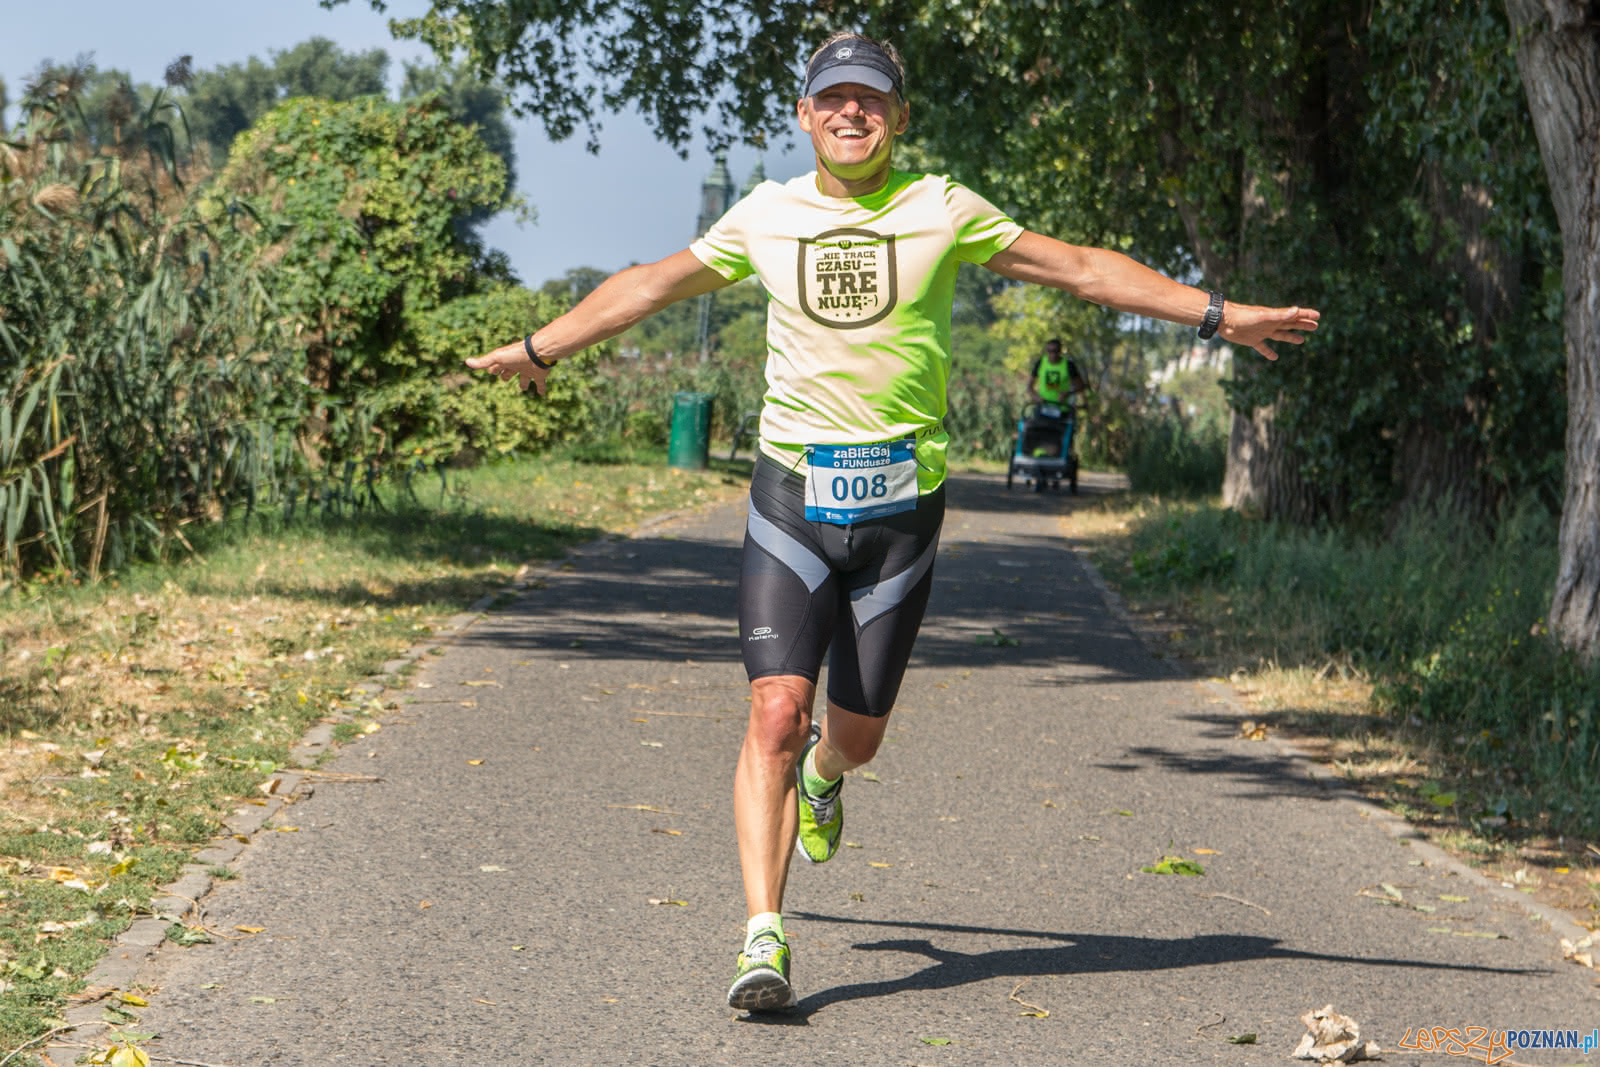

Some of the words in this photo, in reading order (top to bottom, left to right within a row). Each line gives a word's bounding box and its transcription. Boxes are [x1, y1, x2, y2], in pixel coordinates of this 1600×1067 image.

[816, 260, 861, 272] CZASU
[816, 271, 877, 295] TRE
[833, 445, 890, 459] zaBIEGaj
[832, 474, 887, 501] 008
